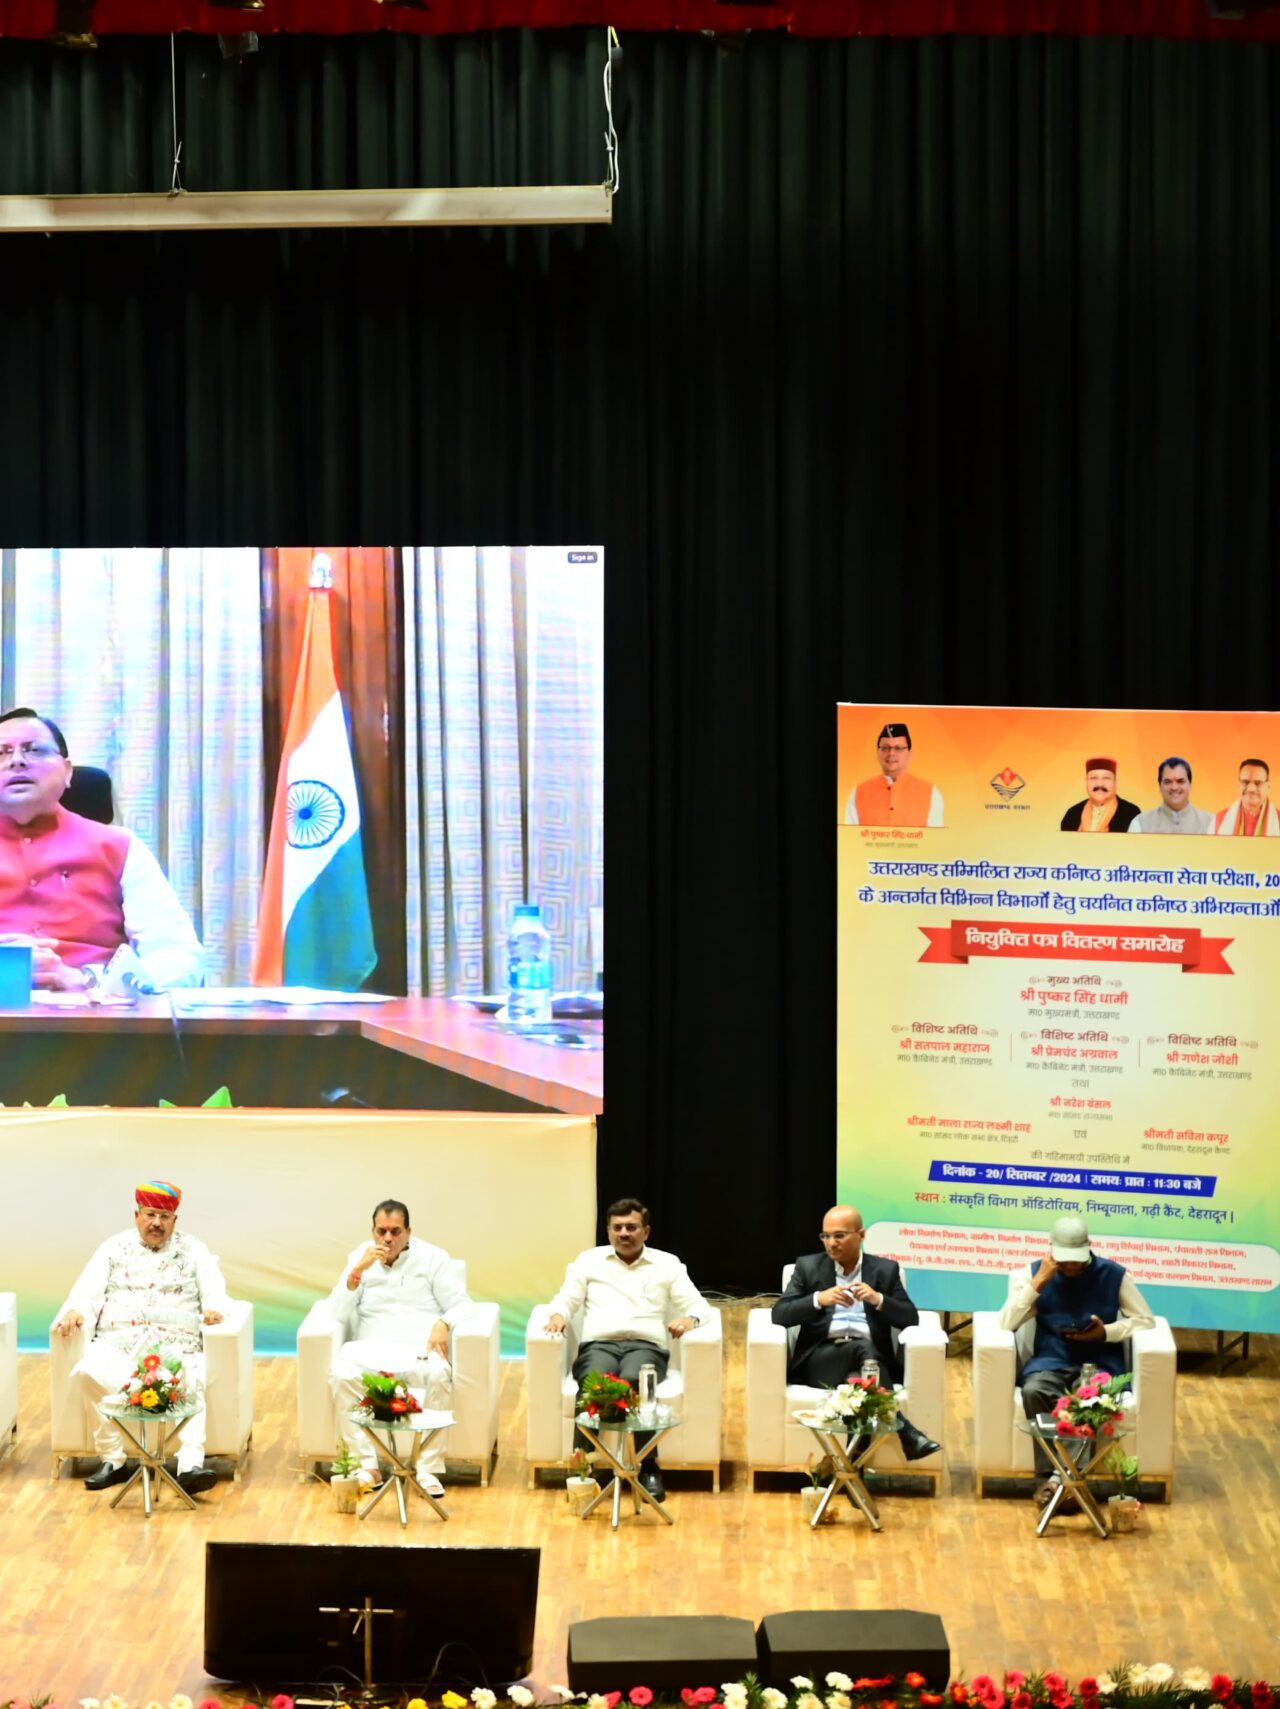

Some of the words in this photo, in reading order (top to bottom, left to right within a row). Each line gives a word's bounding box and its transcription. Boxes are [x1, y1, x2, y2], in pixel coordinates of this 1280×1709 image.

[869, 862, 938, 877] उत्तराखण्ड
[942, 860, 1009, 878] सम्मिलित
[1014, 866, 1047, 879] राज्य
[1051, 863, 1101, 881] कनिष्ठ
[1104, 865, 1173, 884] अभियन्ता
[1177, 868, 1207, 885] सेवा
[1212, 868, 1260, 888] परीक्षा,
[1265, 874, 1280, 886] 20
[859, 886, 874, 902] के
[879, 887, 937, 904] अन्तर्गत
[941, 888, 994, 906] विभिन्न
[998, 890, 1049, 909] विभागों
[1053, 892, 1076, 914] हेतु
[1080, 893, 1133, 911] चयनित
[1136, 895, 1187, 913] कनिष्ठ
[966, 927, 1029, 949] नियुक्ति
[1033, 933, 1058, 947] पत्र
[1062, 931, 1117, 949] वितरण
[1120, 934, 1184, 952] समारोह
[1047, 977, 1069, 986] मुख्य
[1072, 976, 1101, 986] अतिथि
[1021, 988, 1034, 1001] श्री
[1038, 991, 1071, 1005] पुष्कर
[1074, 989, 1096, 1004] सिंह
[1100, 990, 1128, 1005] धामी
[900, 1038, 911, 1049] श्री
[914, 1041, 950, 1050] सतपाल
[953, 1043, 990, 1053] महाराज
[1031, 1045, 1043, 1056] श्री
[1046, 1048, 1077, 1057] प्रेमचंद
[1080, 1049, 1117, 1059] अग्रवाल
[943, 1164, 976, 1176] दिनांक
[986, 1169, 1003, 1180] 20/
[1006, 1168, 1047, 1181] सितम्बर
[1049, 1172, 1080, 1183] /2024
[1125, 1176, 1144, 1187] प्रात
[1154, 1179, 1180, 1189] 11:30
[1183, 1178, 1201, 1191] बजे
[915, 1192, 940, 1203] स्थान
[949, 1192, 985, 1208] संस्कृति
[988, 1195, 1018, 1207] विभाग
[1022, 1196, 1082, 1214] ऑडिटोरियम,
[1087, 1200, 1137, 1217] निम्बूवाला,
[1188, 1206, 1227, 1224] देहरादून
